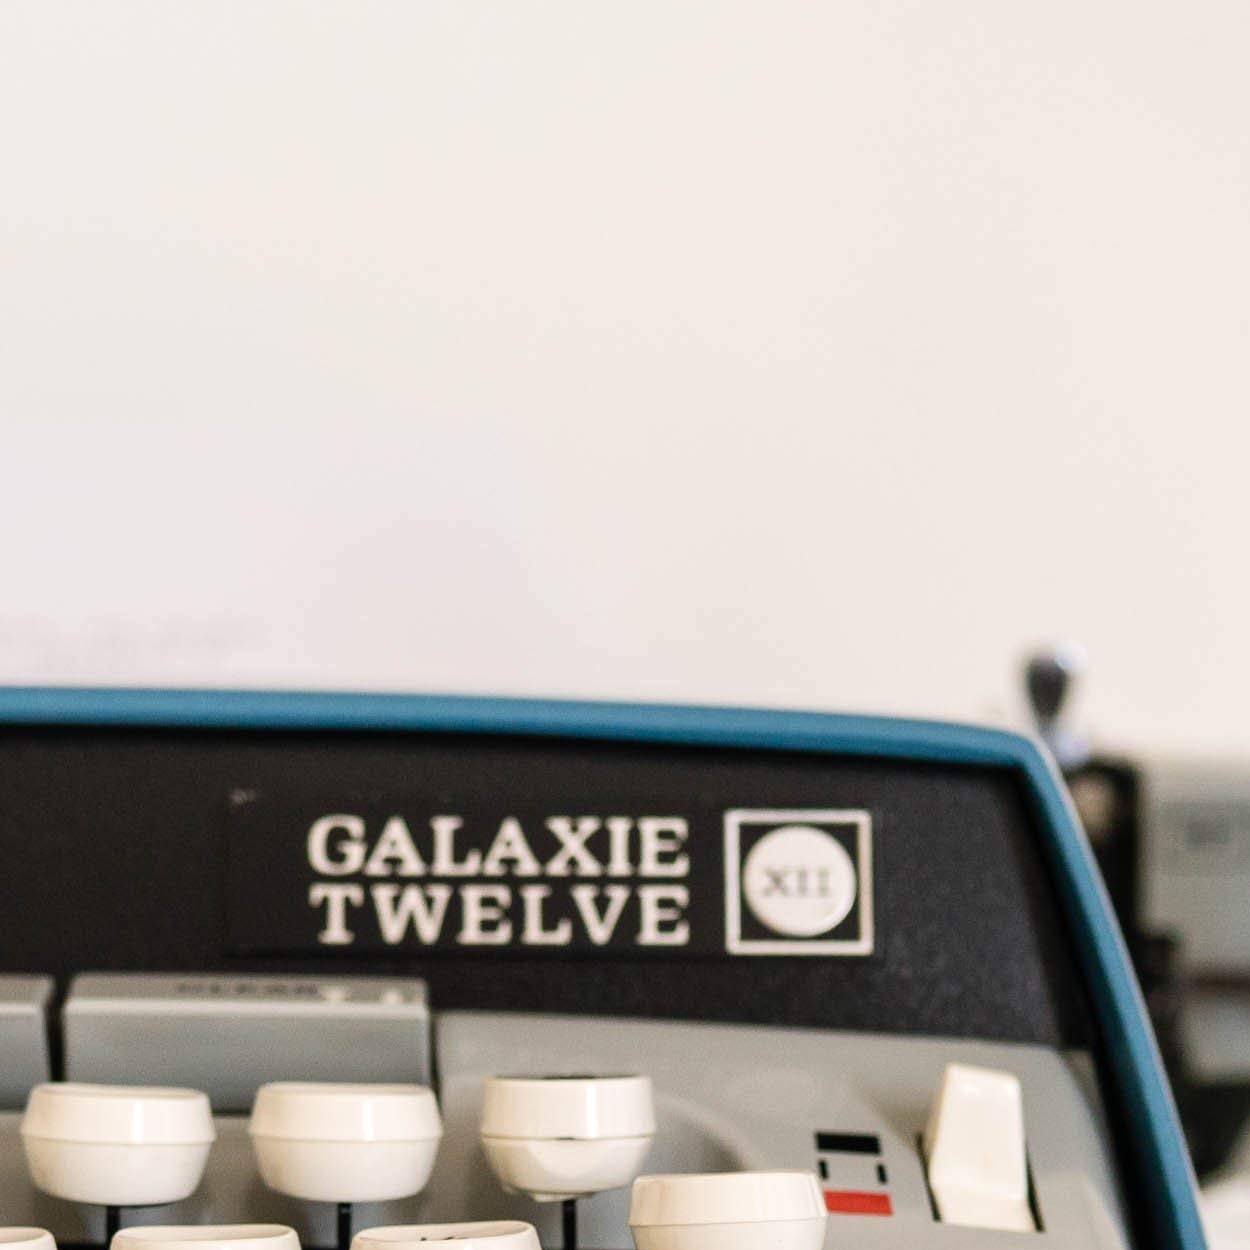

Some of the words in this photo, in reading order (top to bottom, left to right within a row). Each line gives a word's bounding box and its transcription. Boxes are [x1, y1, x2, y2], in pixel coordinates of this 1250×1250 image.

[306, 813, 691, 878] GALAXIE
[762, 866, 832, 898] XII
[307, 883, 691, 946] TWELVE
